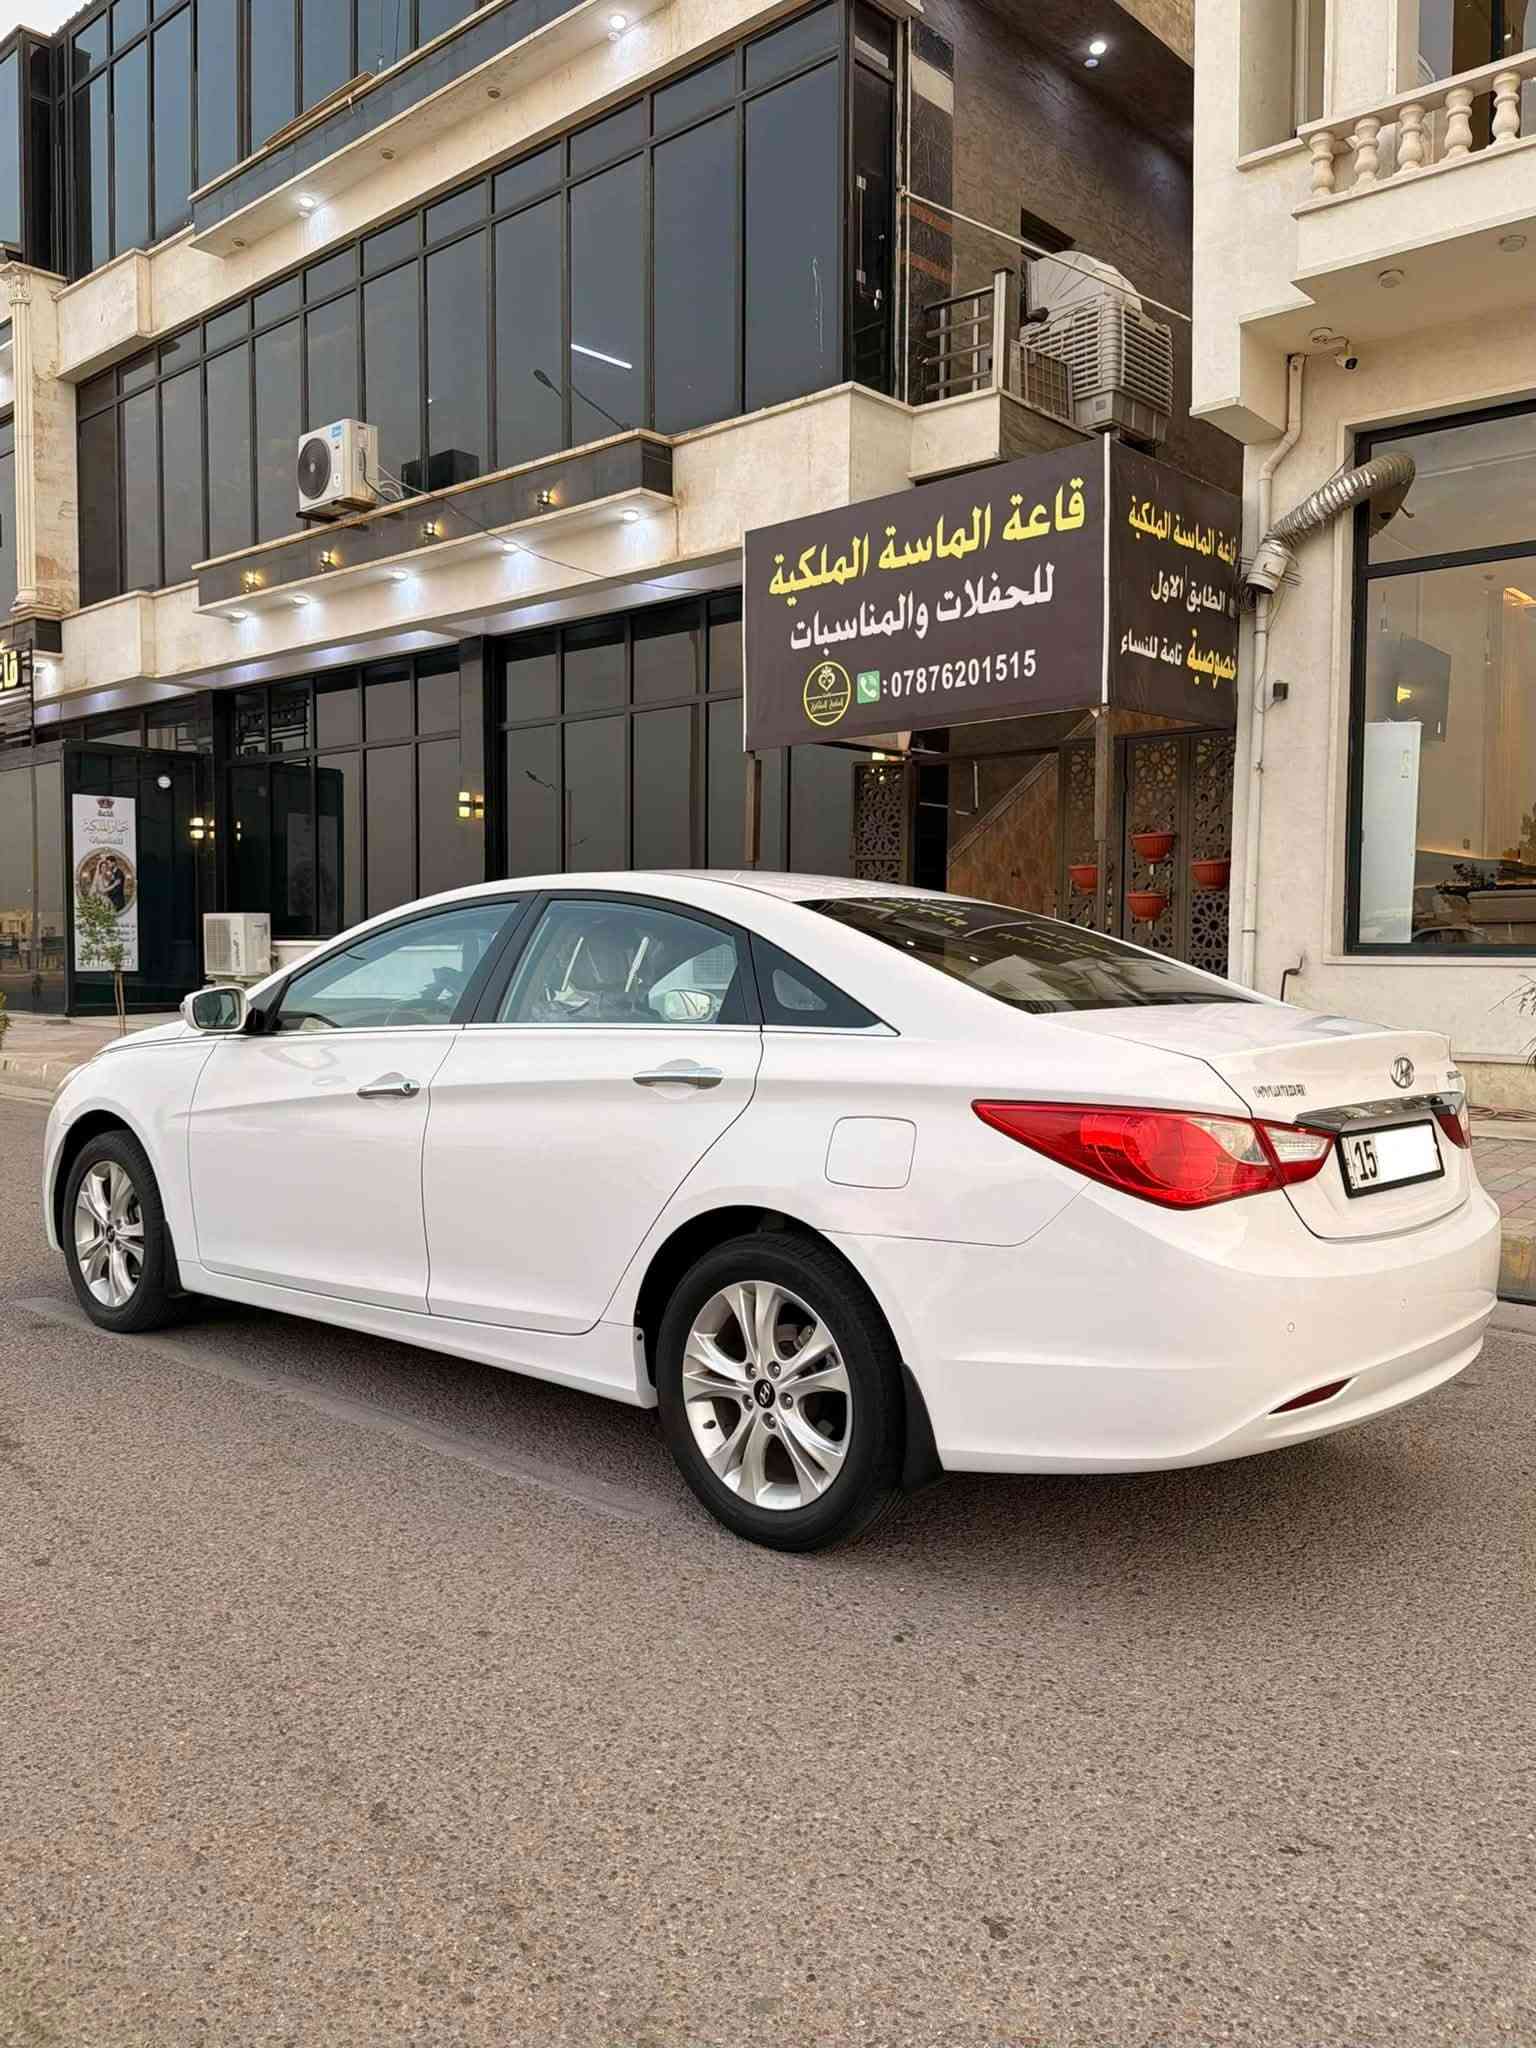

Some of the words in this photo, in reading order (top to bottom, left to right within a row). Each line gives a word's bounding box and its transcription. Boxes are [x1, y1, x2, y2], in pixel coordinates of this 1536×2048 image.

[1002, 477, 1086, 541] قاعة
[1128, 495, 1171, 541] الملكية
[878, 502, 992, 570] الماسة
[1173, 513, 1215, 556] الماسة
[768, 532, 869, 607] الملكية
[936, 561, 1055, 622] للحفلات
[1151, 570, 1184, 602] الاول
[1186, 581, 1226, 613] الطابق
[790, 590, 929, 656] والمناسبات
[1120, 628, 1158, 659] للنساء
[1160, 637, 1183, 666] تامة
[1354, 1140, 1377, 1180] 15
